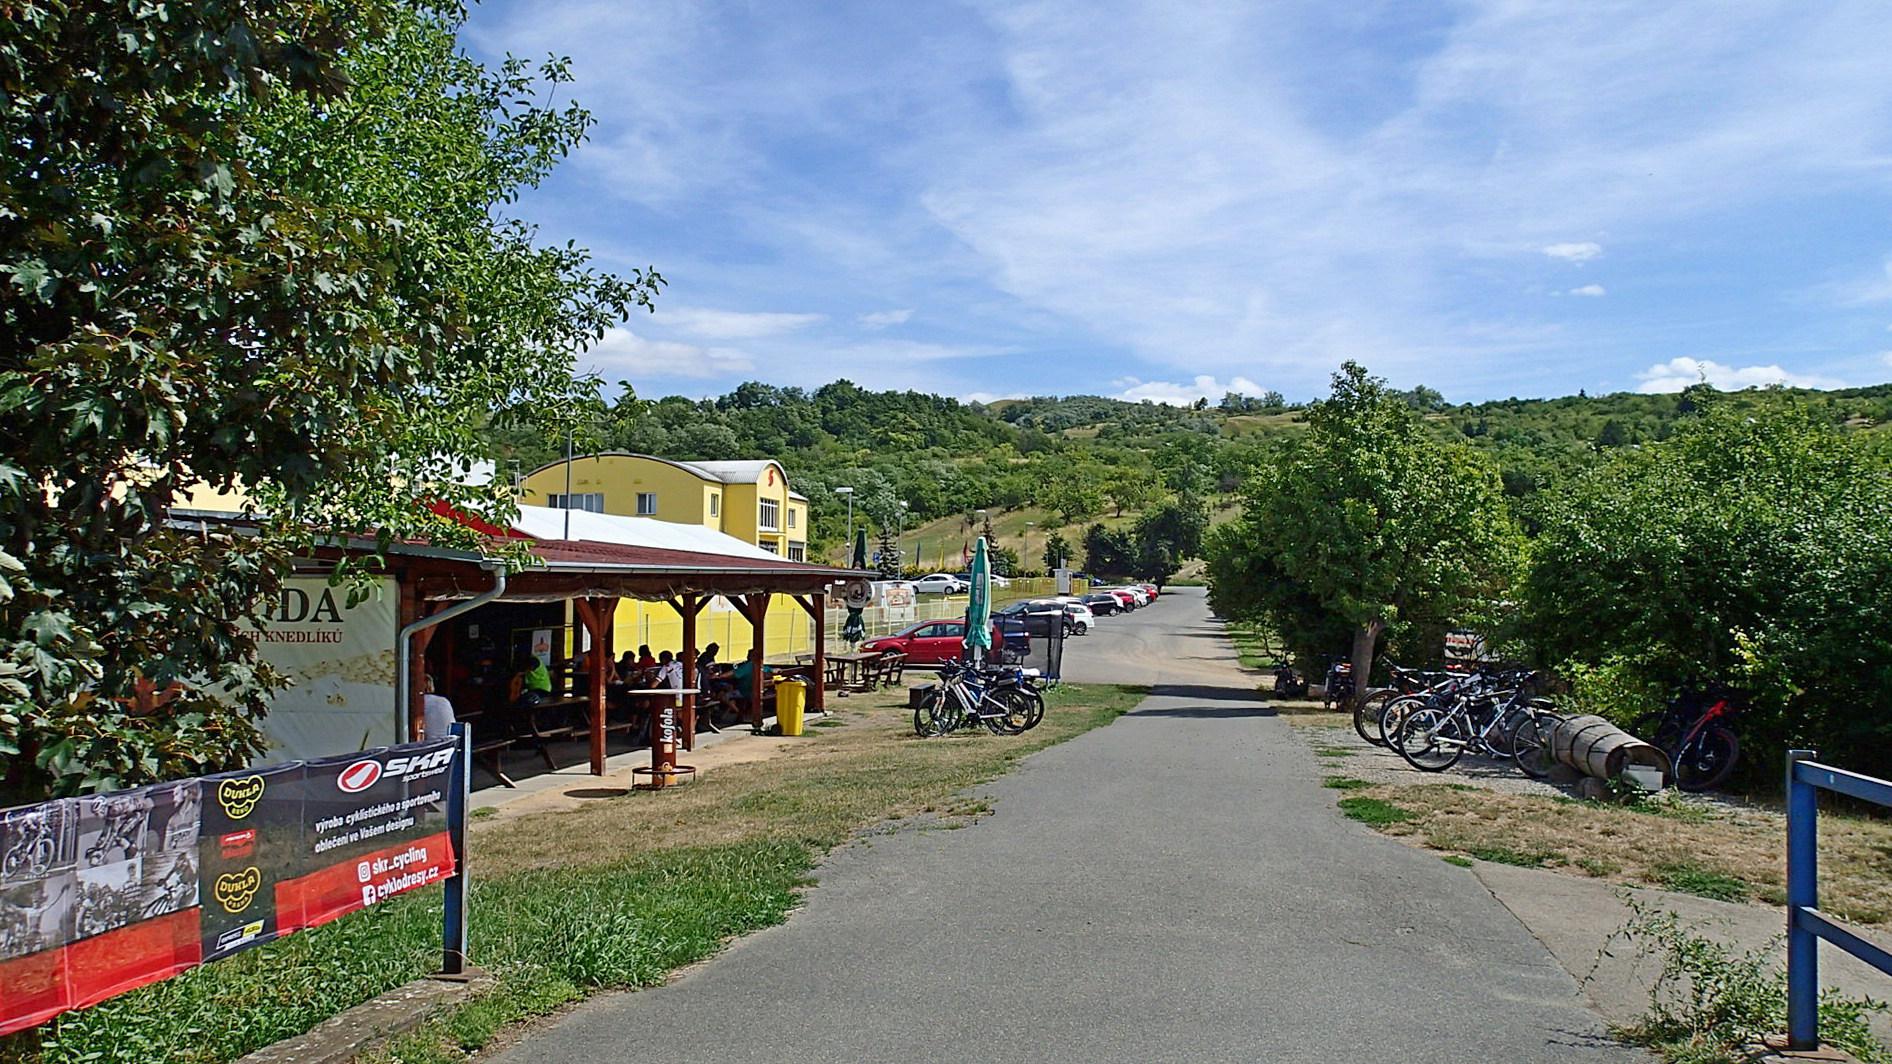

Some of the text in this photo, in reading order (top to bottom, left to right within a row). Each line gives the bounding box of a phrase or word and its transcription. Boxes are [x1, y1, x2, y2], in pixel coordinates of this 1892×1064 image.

[265, 628, 343, 643] KNEDLÍKŮ
[659, 708, 676, 743] kofola
[401, 765, 448, 783] sportswear
[223, 783, 260, 800] DUKLA
[315, 816, 344, 834] výroba
[345, 802, 395, 825] cyklistického
[315, 816, 415, 853] oblečení ve Vašem designu
[372, 847, 427, 875] skr_cycling
[219, 875, 255, 893] DUKLA
[377, 866, 439, 898] cyklodresy.cz
